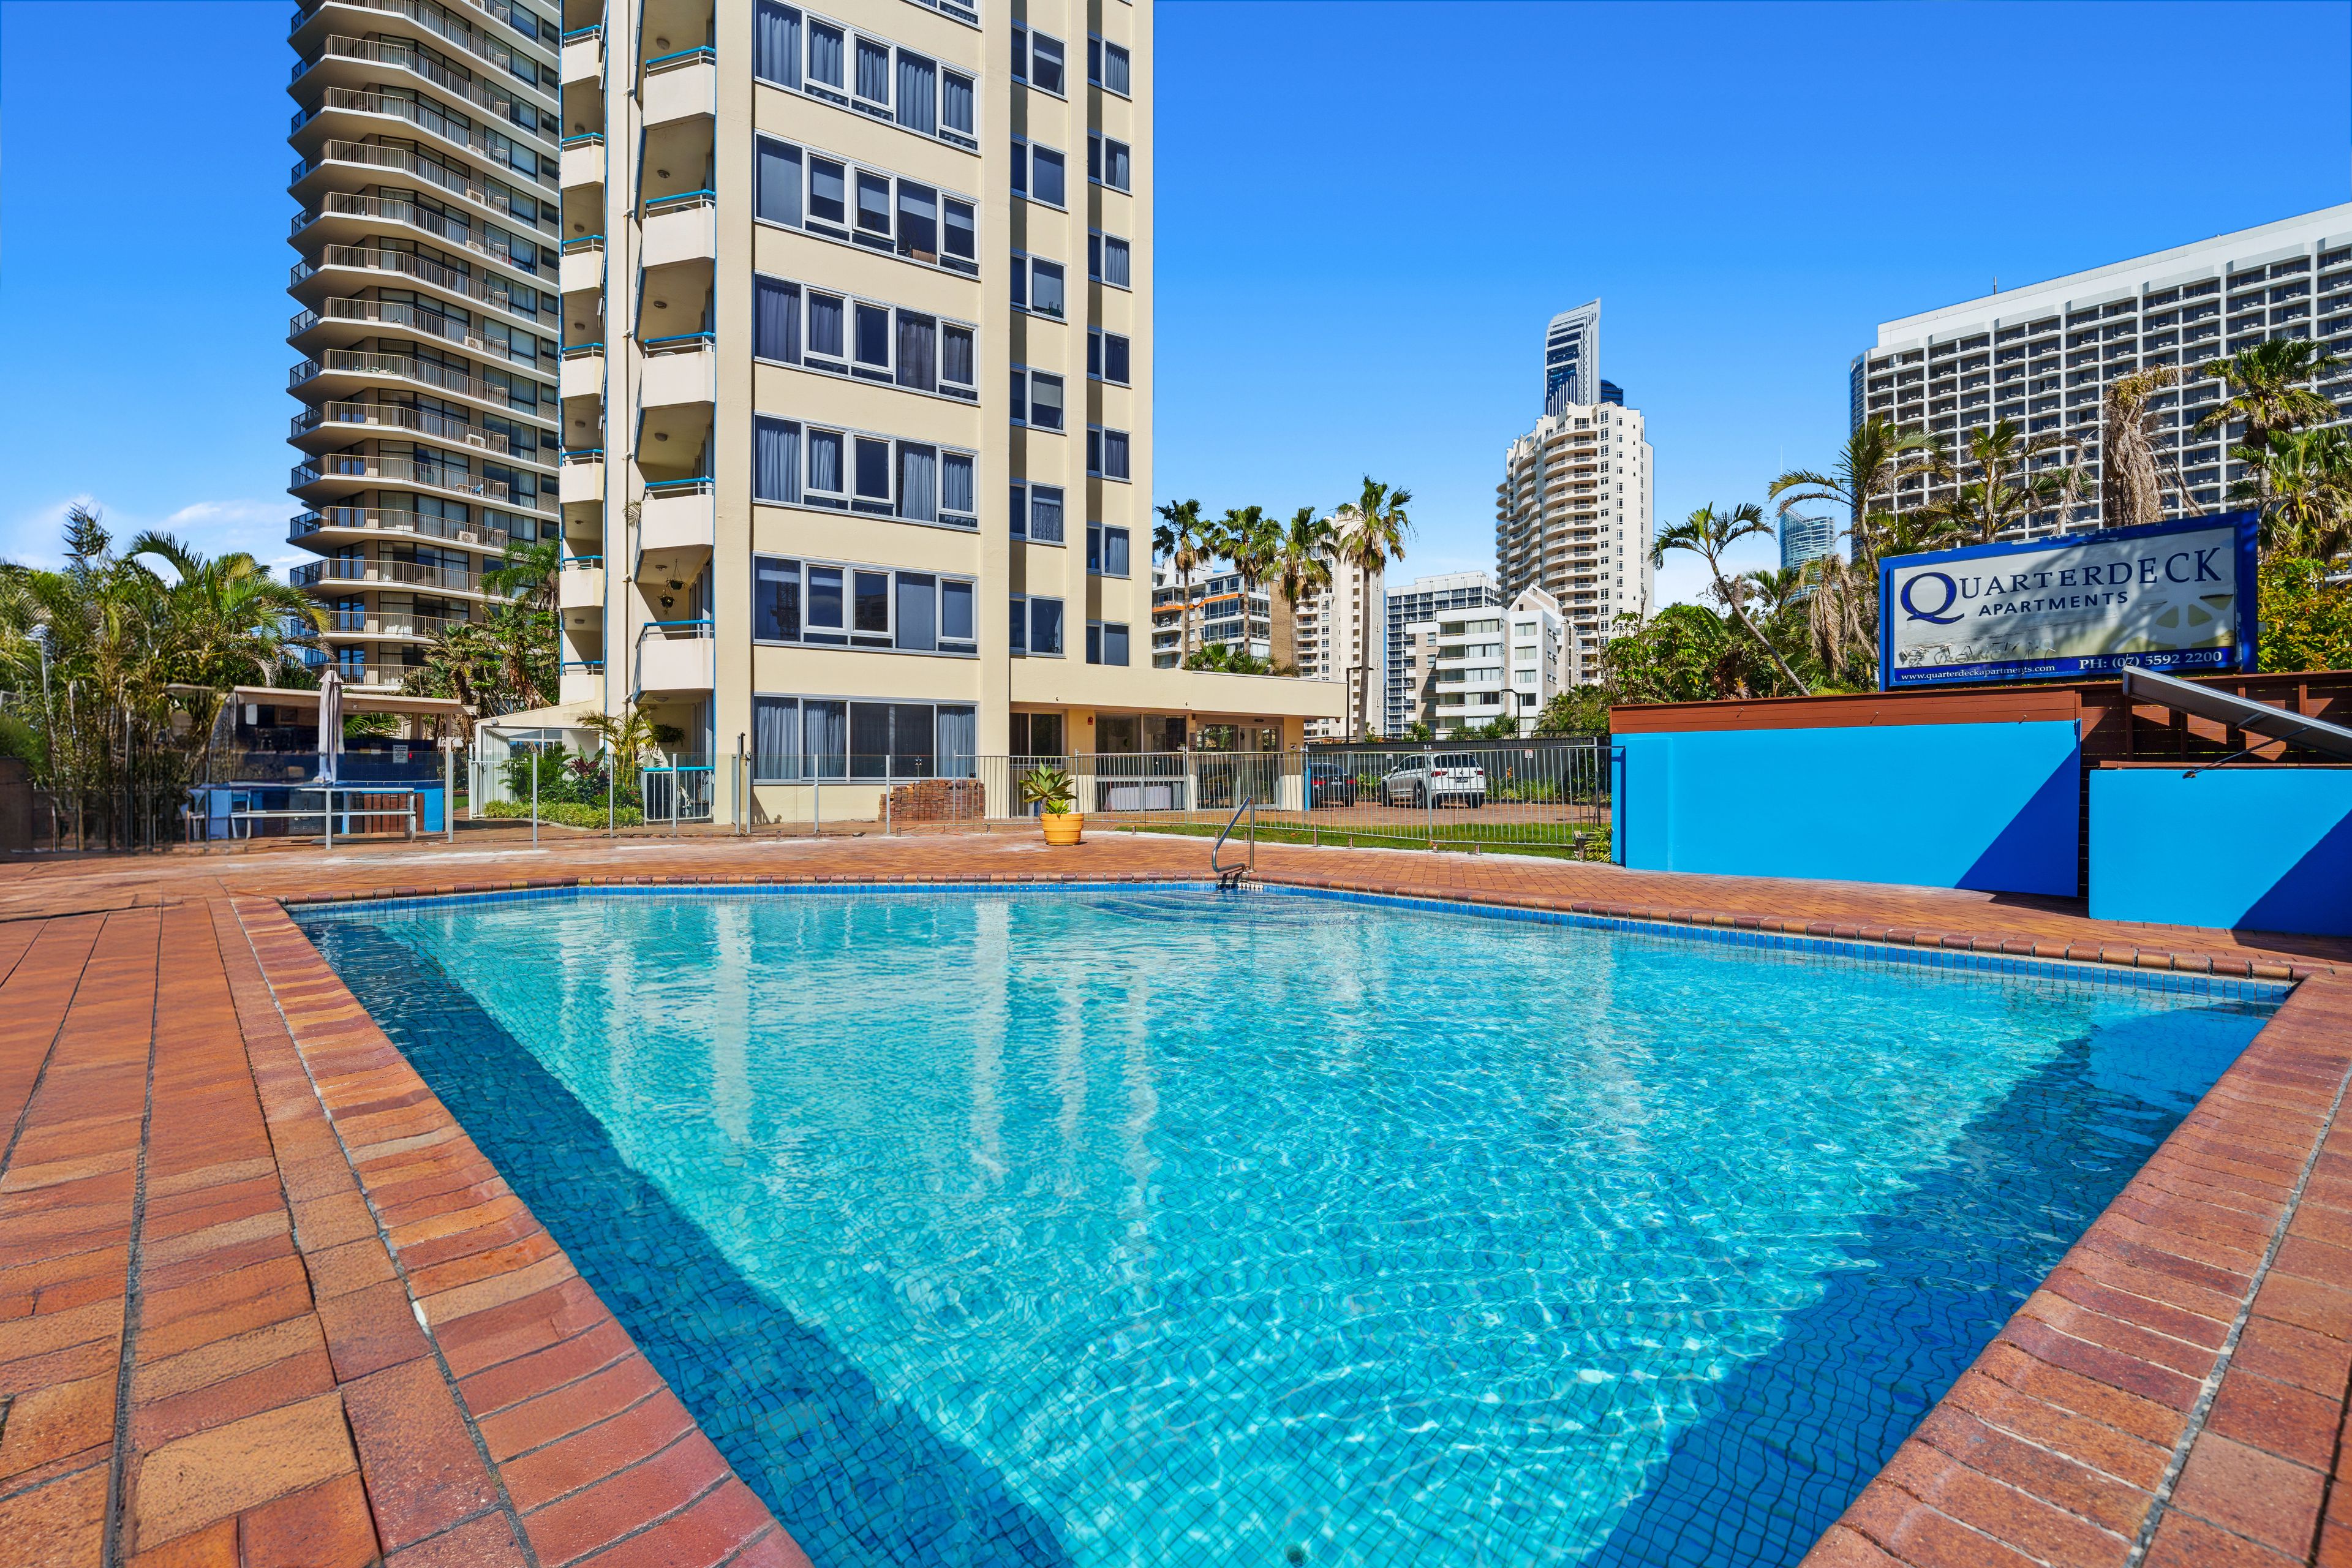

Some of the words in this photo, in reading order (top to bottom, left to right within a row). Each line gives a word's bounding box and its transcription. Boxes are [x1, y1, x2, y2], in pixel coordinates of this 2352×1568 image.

[1900, 547, 2222, 625] QUARTERDECK
[1978, 591, 2128, 617] APARTMENTS
[2079, 658, 2107, 669] PH:
[2112, 656, 2140, 668] (07)
[2145, 654, 2180, 665] 5592
[2185, 651, 2223, 663] 2200
[1901, 665, 2056, 680] www.quarterdeckapartments.com
